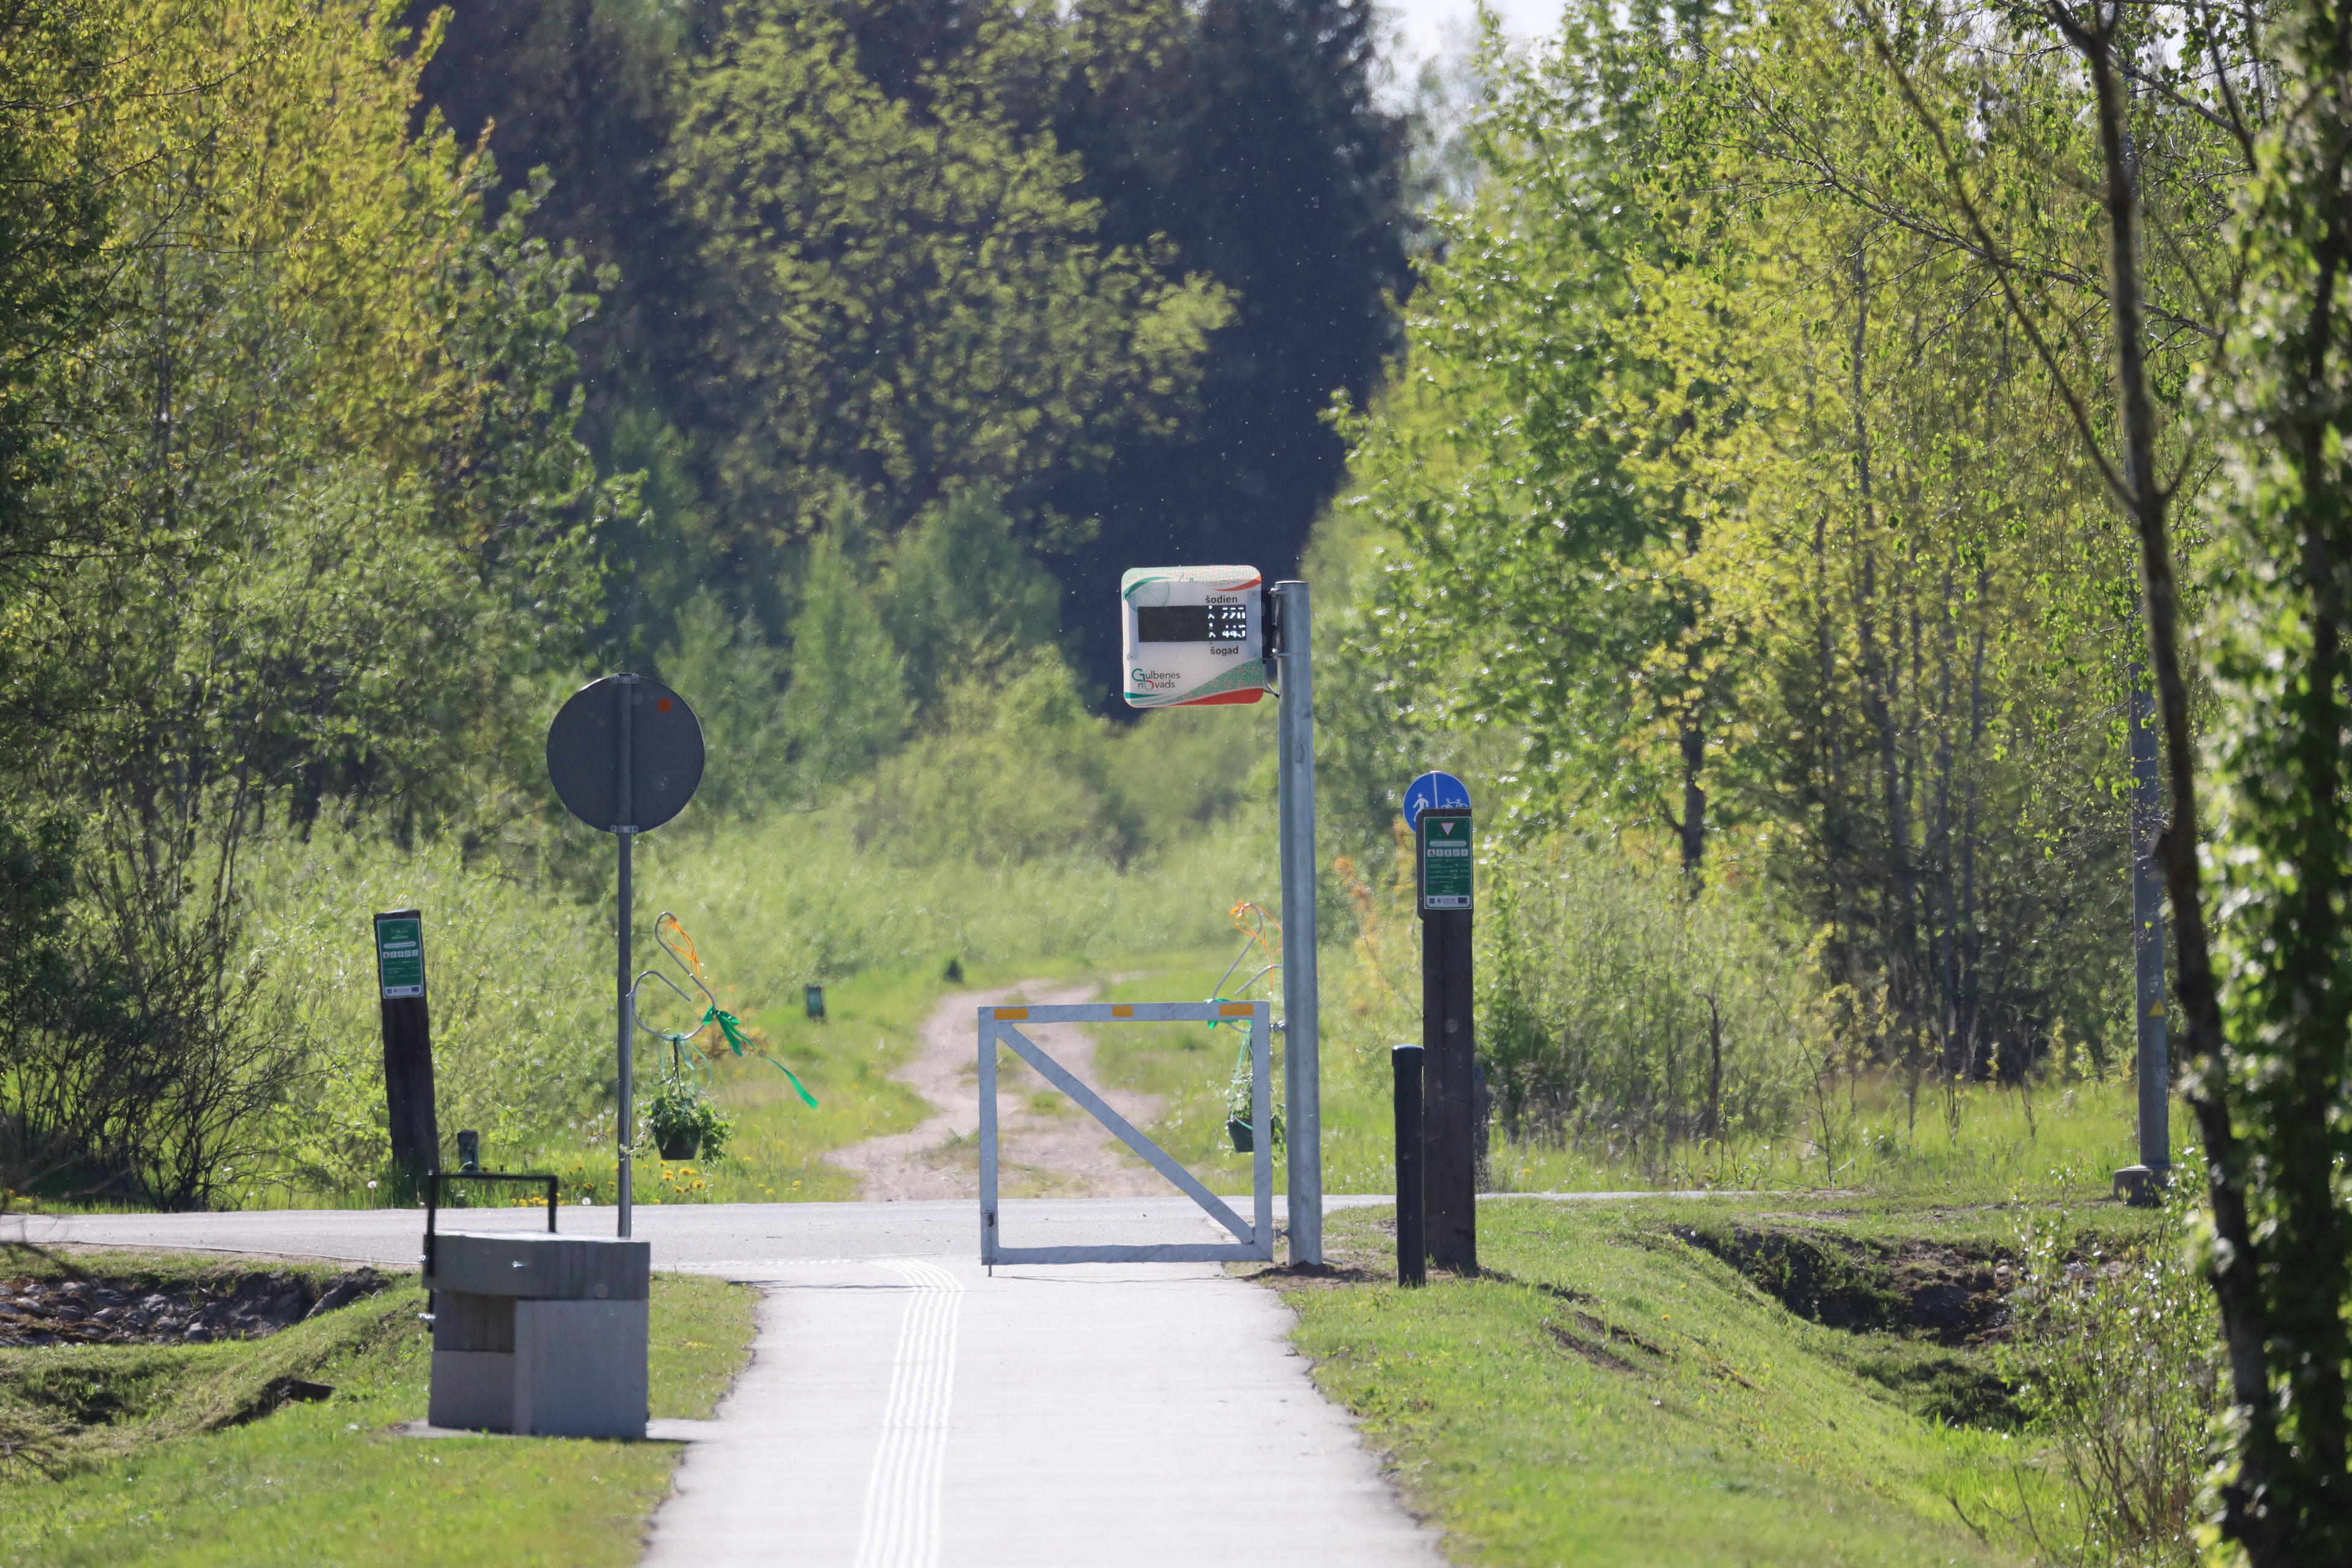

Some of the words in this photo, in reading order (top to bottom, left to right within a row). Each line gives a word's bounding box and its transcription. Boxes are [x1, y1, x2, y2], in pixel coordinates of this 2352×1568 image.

[1205, 595, 1237, 603] šodien
[1210, 646, 1238, 657] šogad
[1131, 668, 1181, 682] Gulbenes
[1138, 679, 1175, 691] novads
